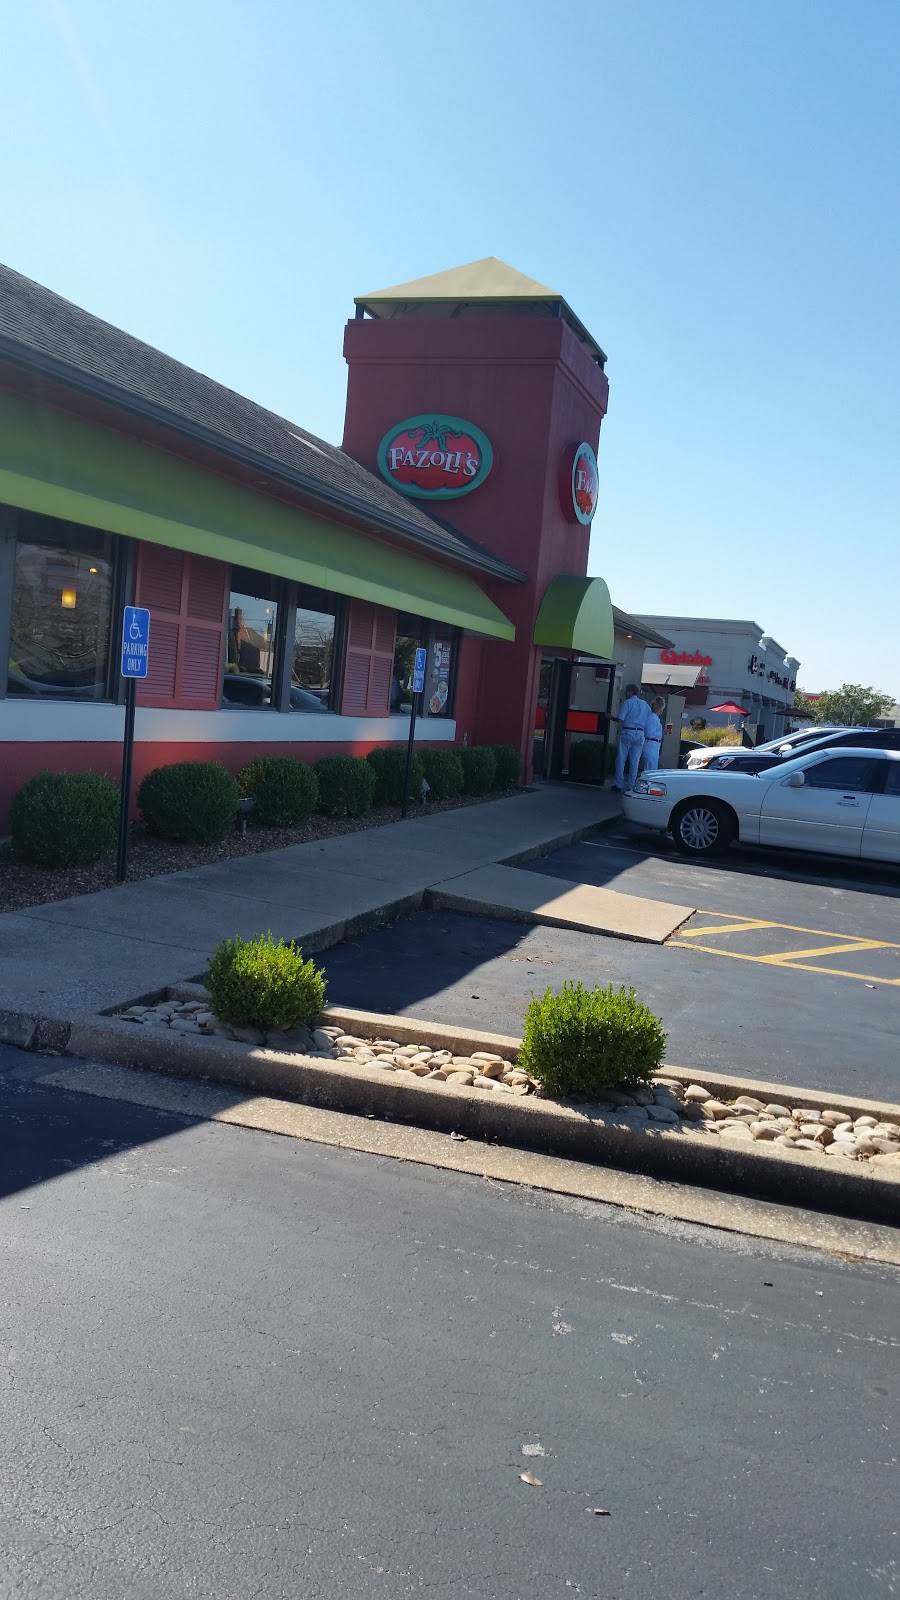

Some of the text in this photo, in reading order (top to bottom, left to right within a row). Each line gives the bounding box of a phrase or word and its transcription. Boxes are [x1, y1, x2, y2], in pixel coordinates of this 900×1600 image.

[389, 447, 479, 476] FAZOLI'S
[123, 641, 147, 657] PARKING
[127, 658, 142, 671] ONLY
